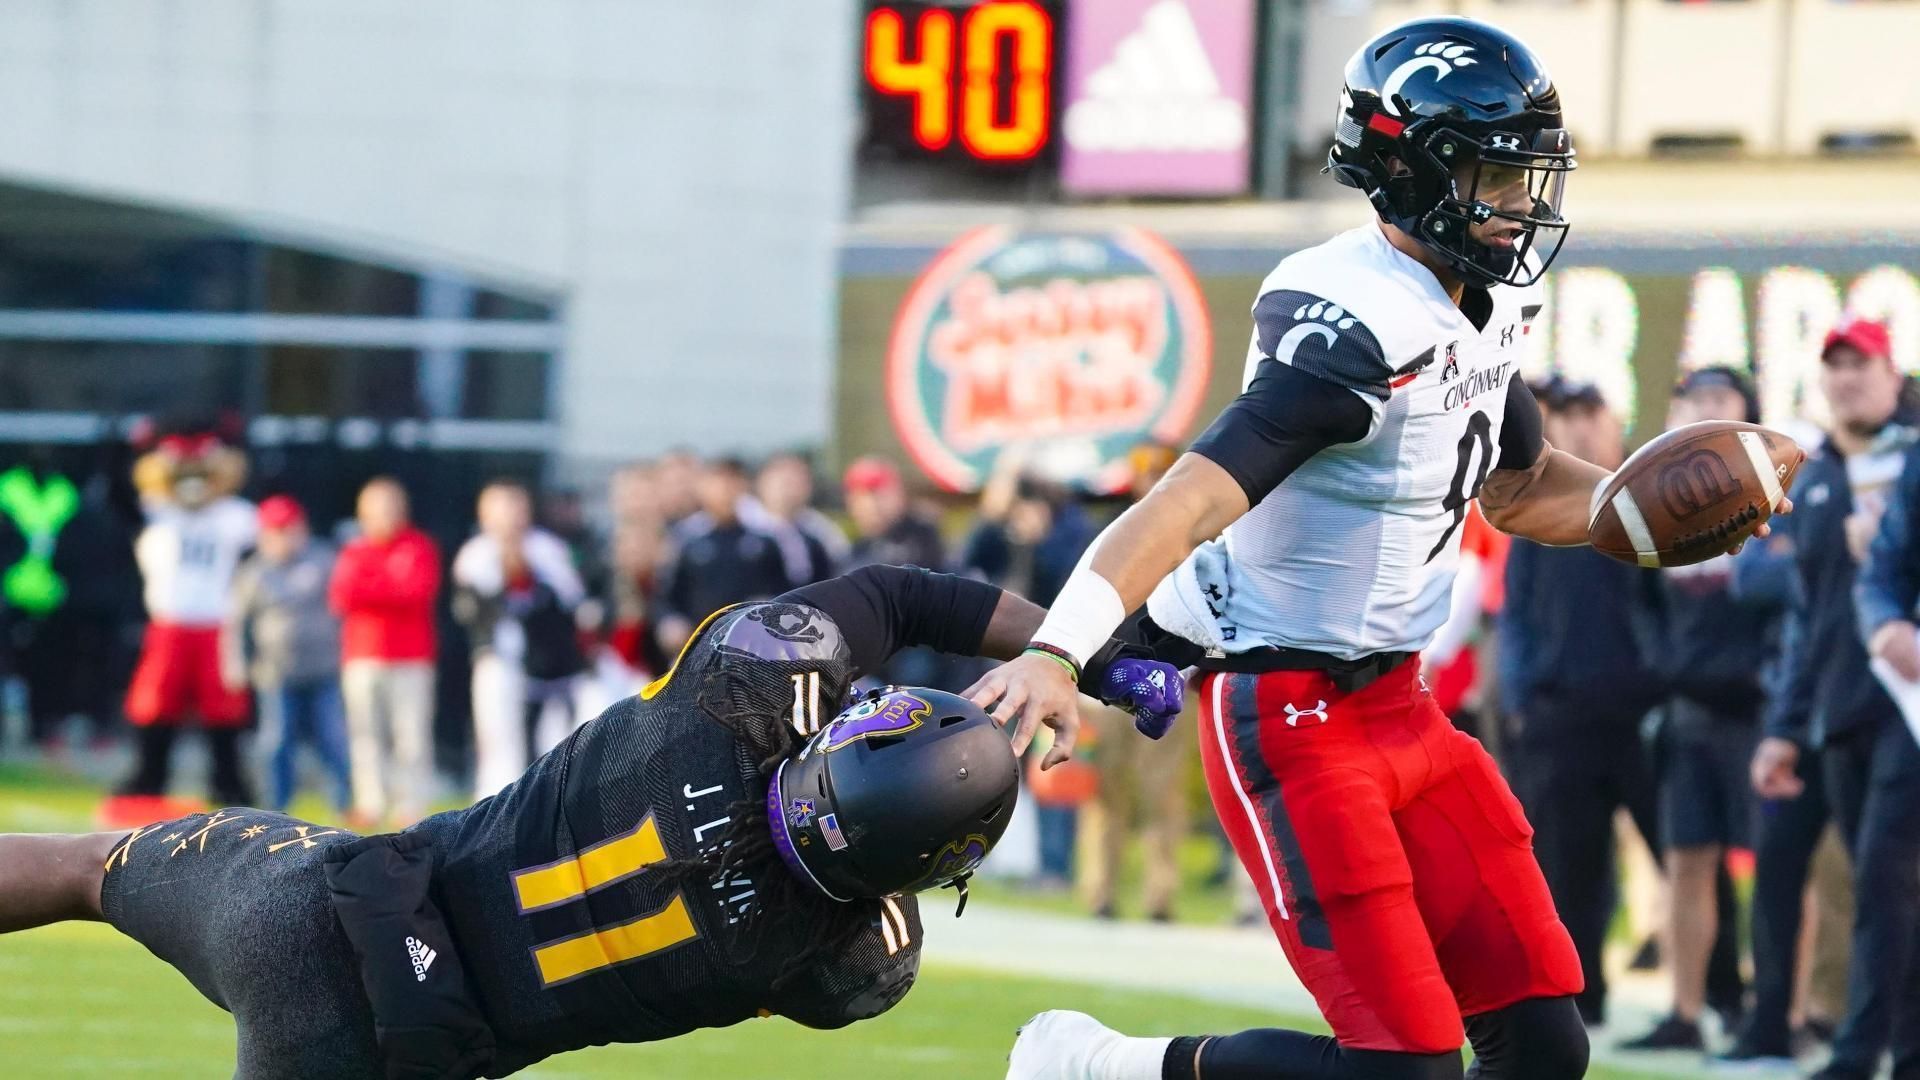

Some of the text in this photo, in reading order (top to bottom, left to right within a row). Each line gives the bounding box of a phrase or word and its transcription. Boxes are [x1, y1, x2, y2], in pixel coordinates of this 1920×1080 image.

[864, 0, 1053, 159] 40
[1424, 409, 1494, 566] 9
[791, 671, 820, 736] 11
[883, 699, 912, 724] ECU
[683, 783, 724, 811] J.
[510, 811, 702, 990] 11
[405, 936, 427, 982] adidas
